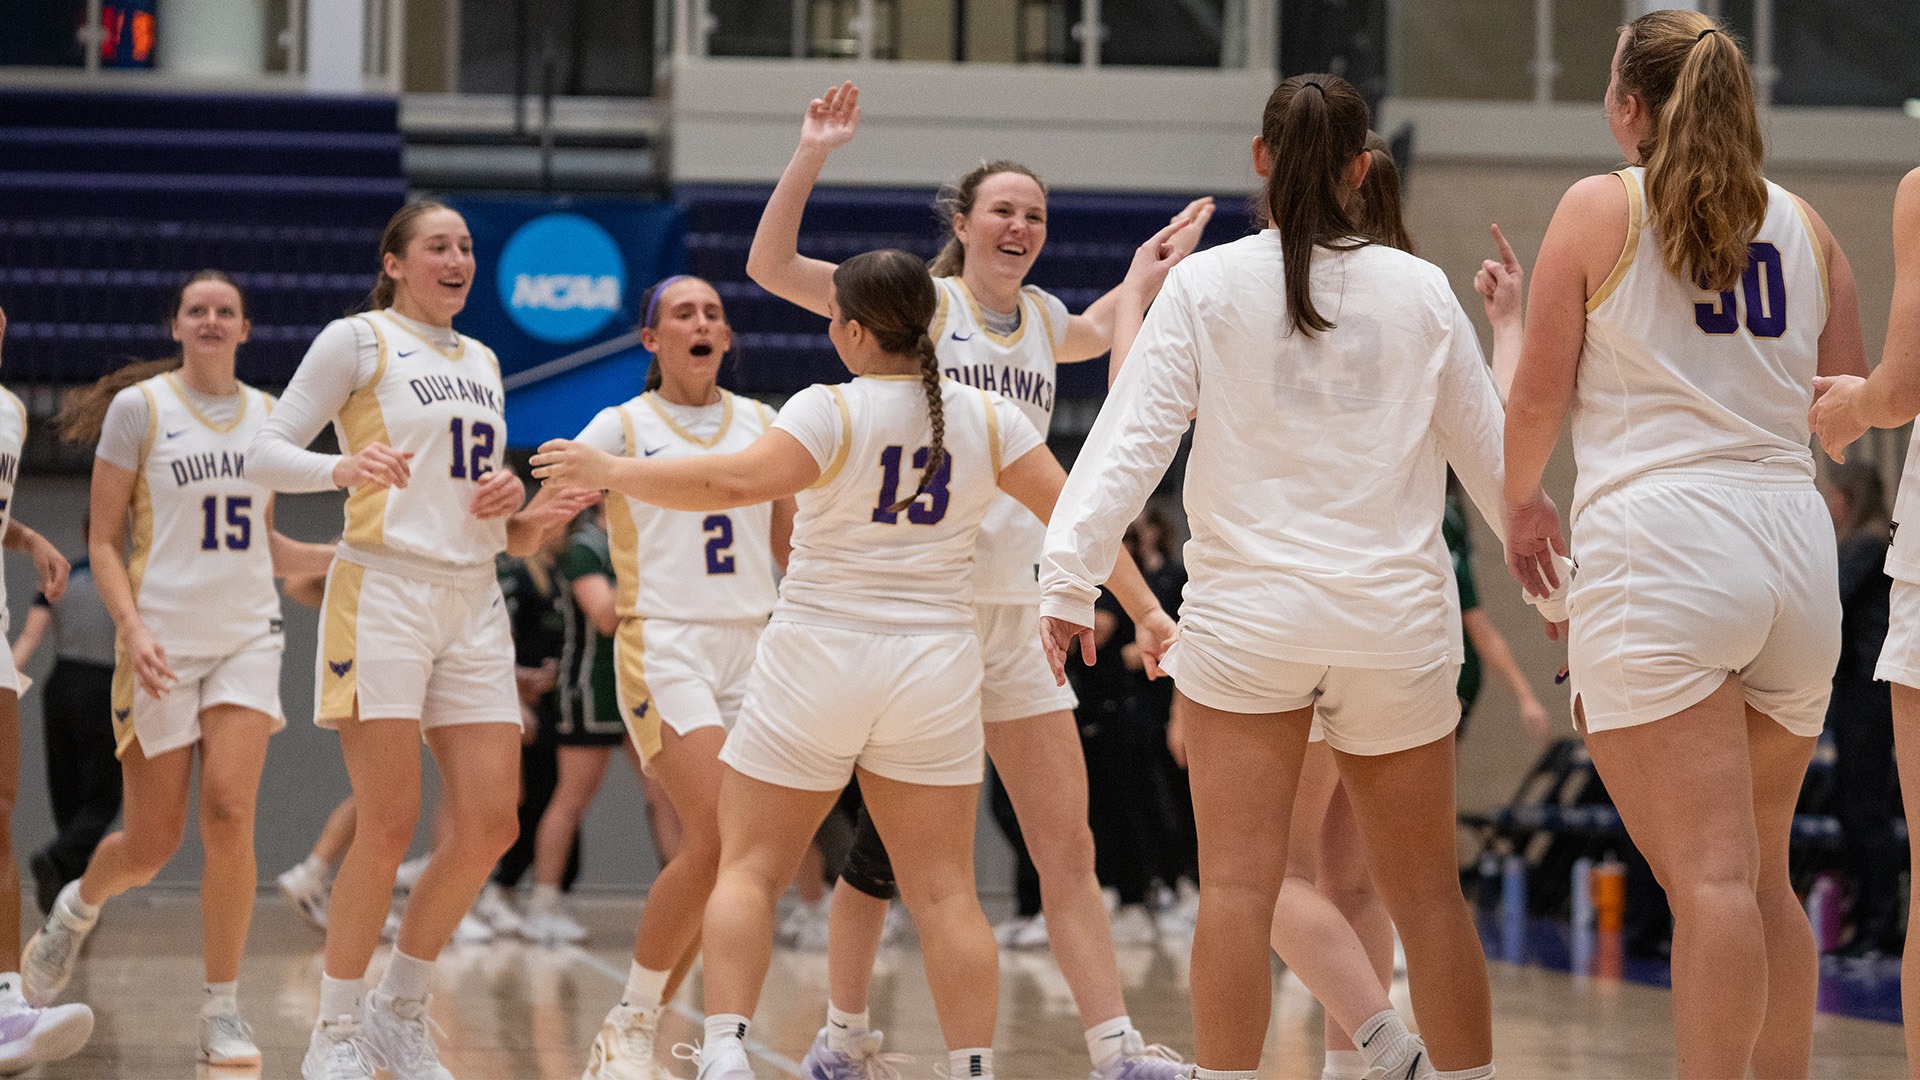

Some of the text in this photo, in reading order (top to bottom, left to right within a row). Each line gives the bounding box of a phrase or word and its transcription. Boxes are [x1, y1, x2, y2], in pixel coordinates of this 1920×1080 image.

[511, 273, 620, 311] NCAA
[409, 375, 502, 413] DUHAWK
[448, 416, 496, 483] 12
[870, 445, 953, 526] 13
[200, 494, 252, 551] 15
[702, 513, 736, 576] 2
